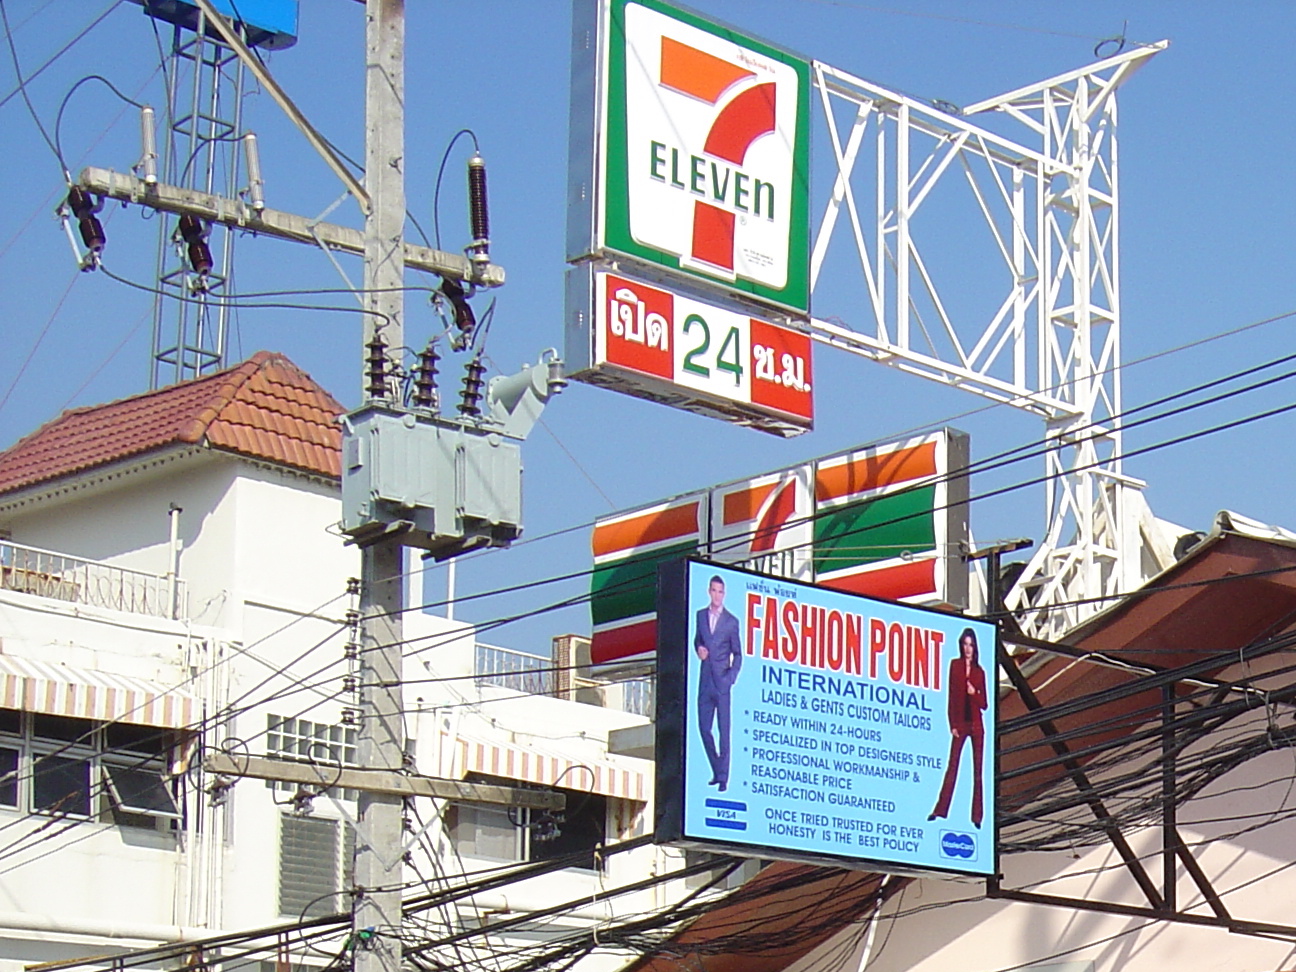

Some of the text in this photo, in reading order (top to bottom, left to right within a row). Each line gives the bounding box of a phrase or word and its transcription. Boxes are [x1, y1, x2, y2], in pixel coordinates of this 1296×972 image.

[610, 288, 669, 352] เปิด
[682, 313, 743, 387] 24
[745, 592, 945, 692] FASHION POINT
[761, 664, 932, 712] INTERNATIONAL
[753, 710, 882, 743] READY WITHIN 24-HOURS
[761, 688, 931, 731] LADIES & GENTS CUSTOM TAILORS
[752, 729, 942, 770] SPECIALIZED IN TOP DESIGNERS STYLE
[752, 747, 921, 783] PROFESSIONAL WORKMANSHIP &
[751, 764, 853, 791] REASONABLE PRICE
[751, 781, 896, 813] SATISFACTION GUARANTEED
[715, 809, 737, 820] VISA
[765, 807, 924, 840] ONCE TRIED TRUSTED FOR EVER
[768, 822, 920, 853] HONESTY IS THE BEST POLICY
